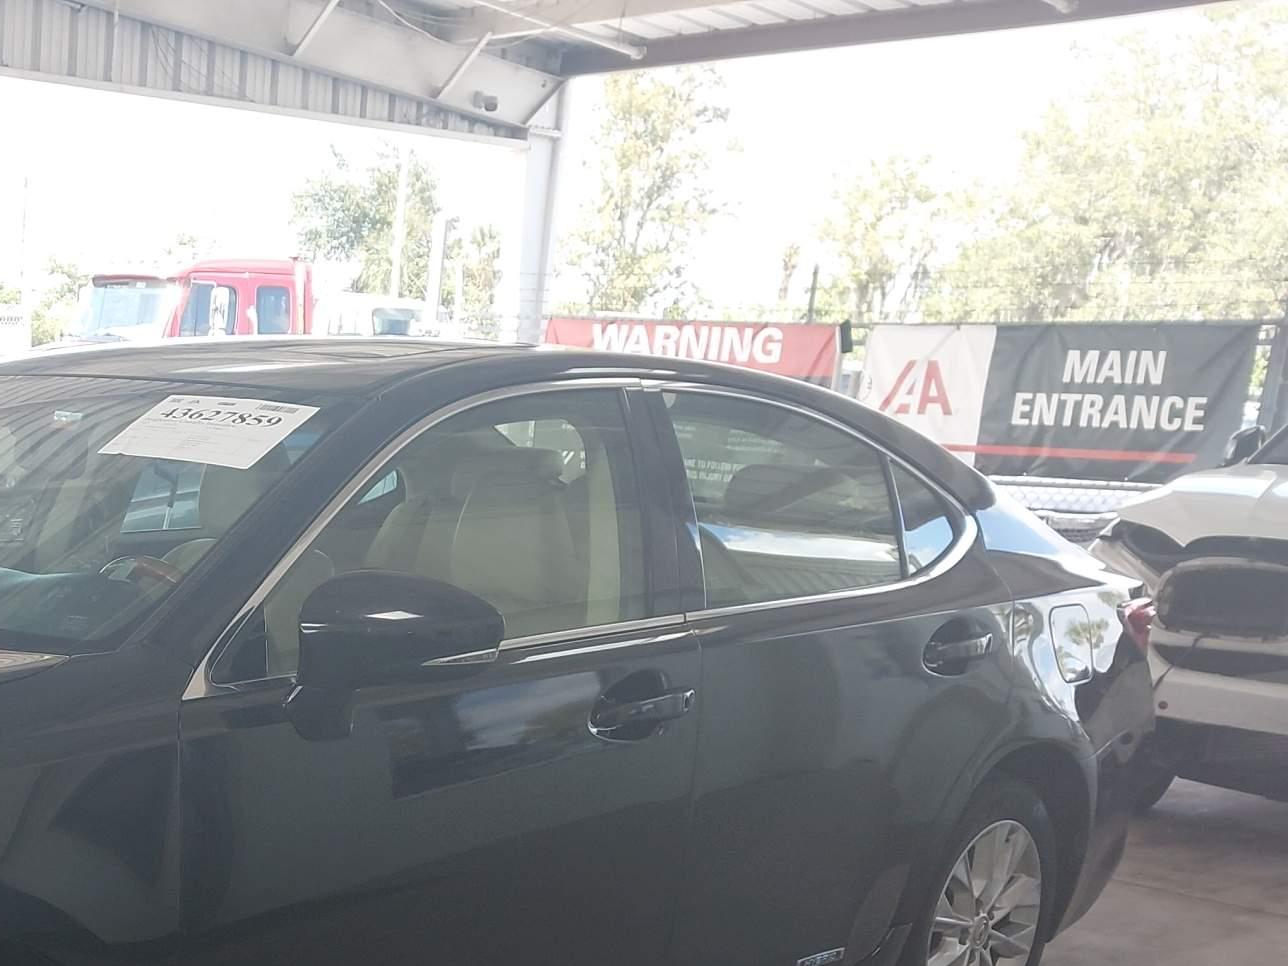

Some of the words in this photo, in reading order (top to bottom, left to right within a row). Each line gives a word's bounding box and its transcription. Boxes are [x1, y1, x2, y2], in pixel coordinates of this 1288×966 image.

[592, 323, 784, 364] WARNING
[1062, 349, 1168, 385] MAIN
[160, 407, 282, 428] 43627859
[1011, 392, 1208, 432] ENTRANCE
